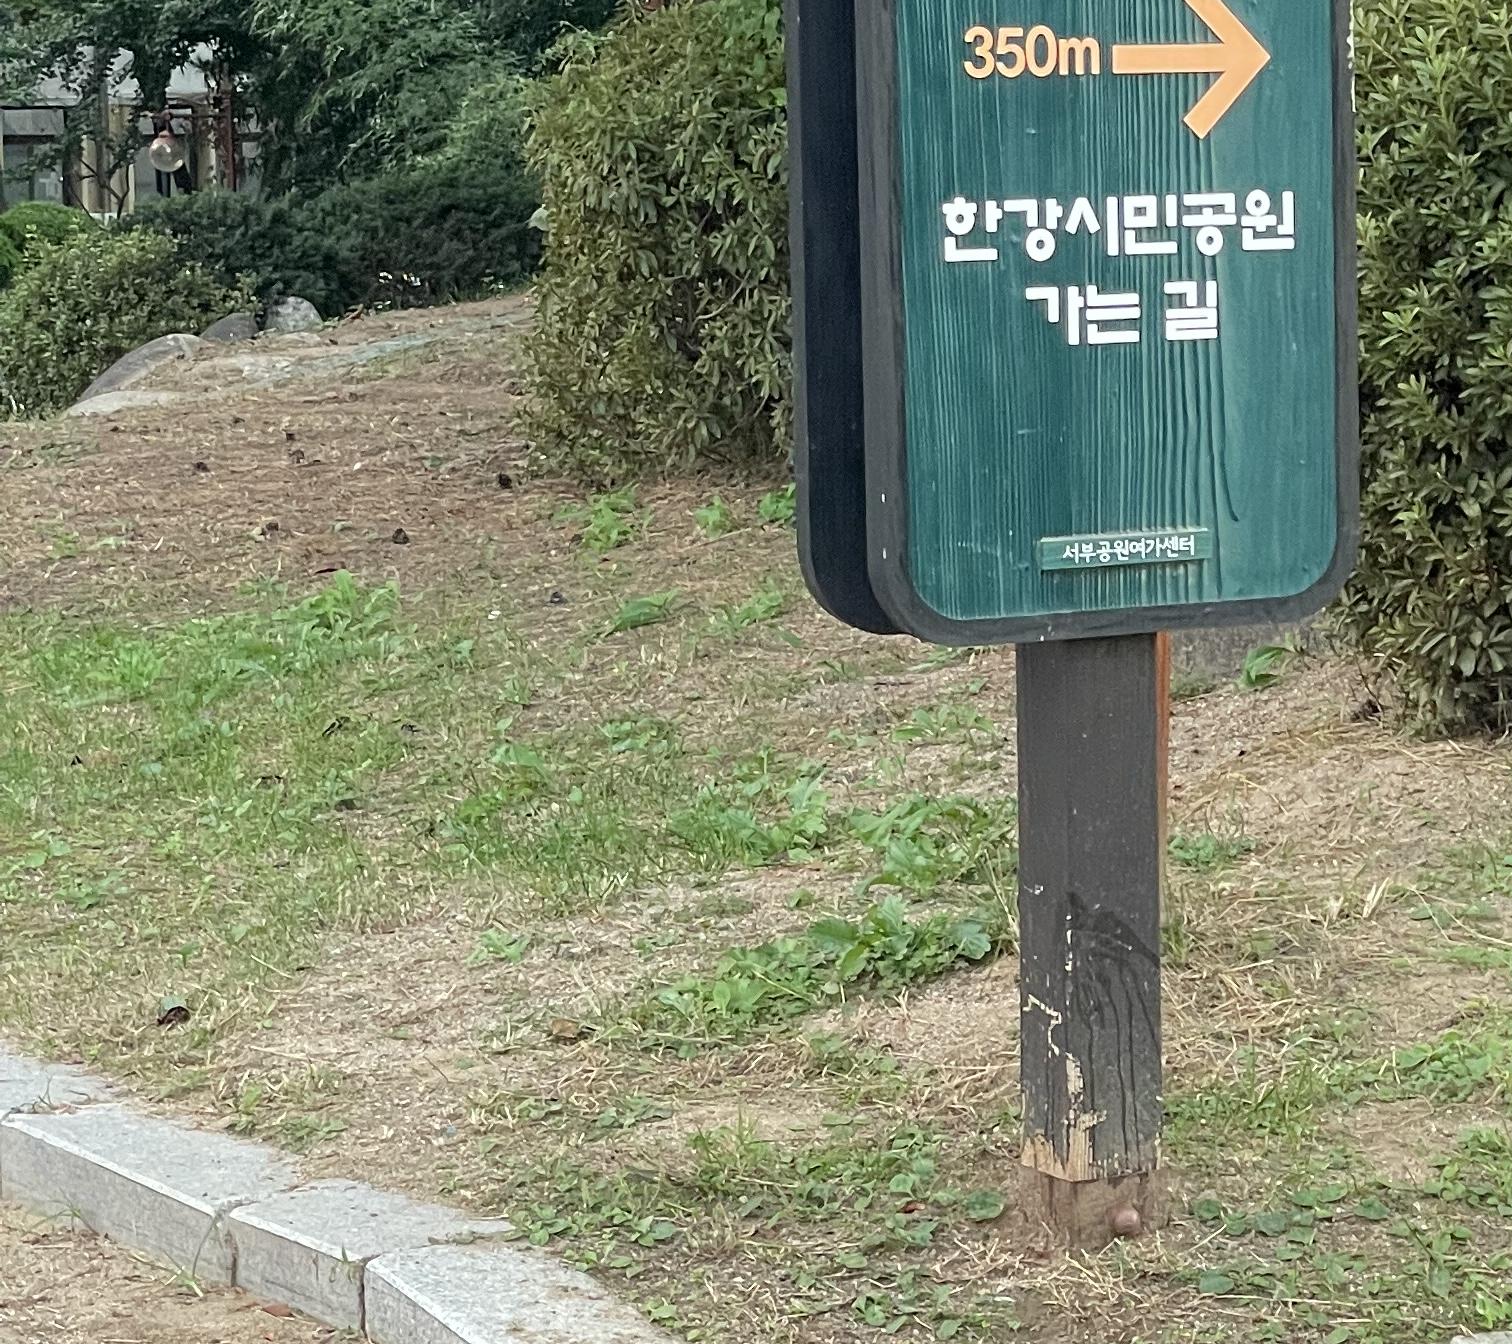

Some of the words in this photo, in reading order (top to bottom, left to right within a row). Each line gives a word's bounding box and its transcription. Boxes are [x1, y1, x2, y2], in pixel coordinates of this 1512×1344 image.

[962, 24, 1101, 81] 350m
[941, 188, 1298, 263] 한강시민공원
[1024, 282, 1141, 348] 가는
[1163, 279, 1220, 342] 길
[1062, 534, 1196, 564] 서부공원여가센터
